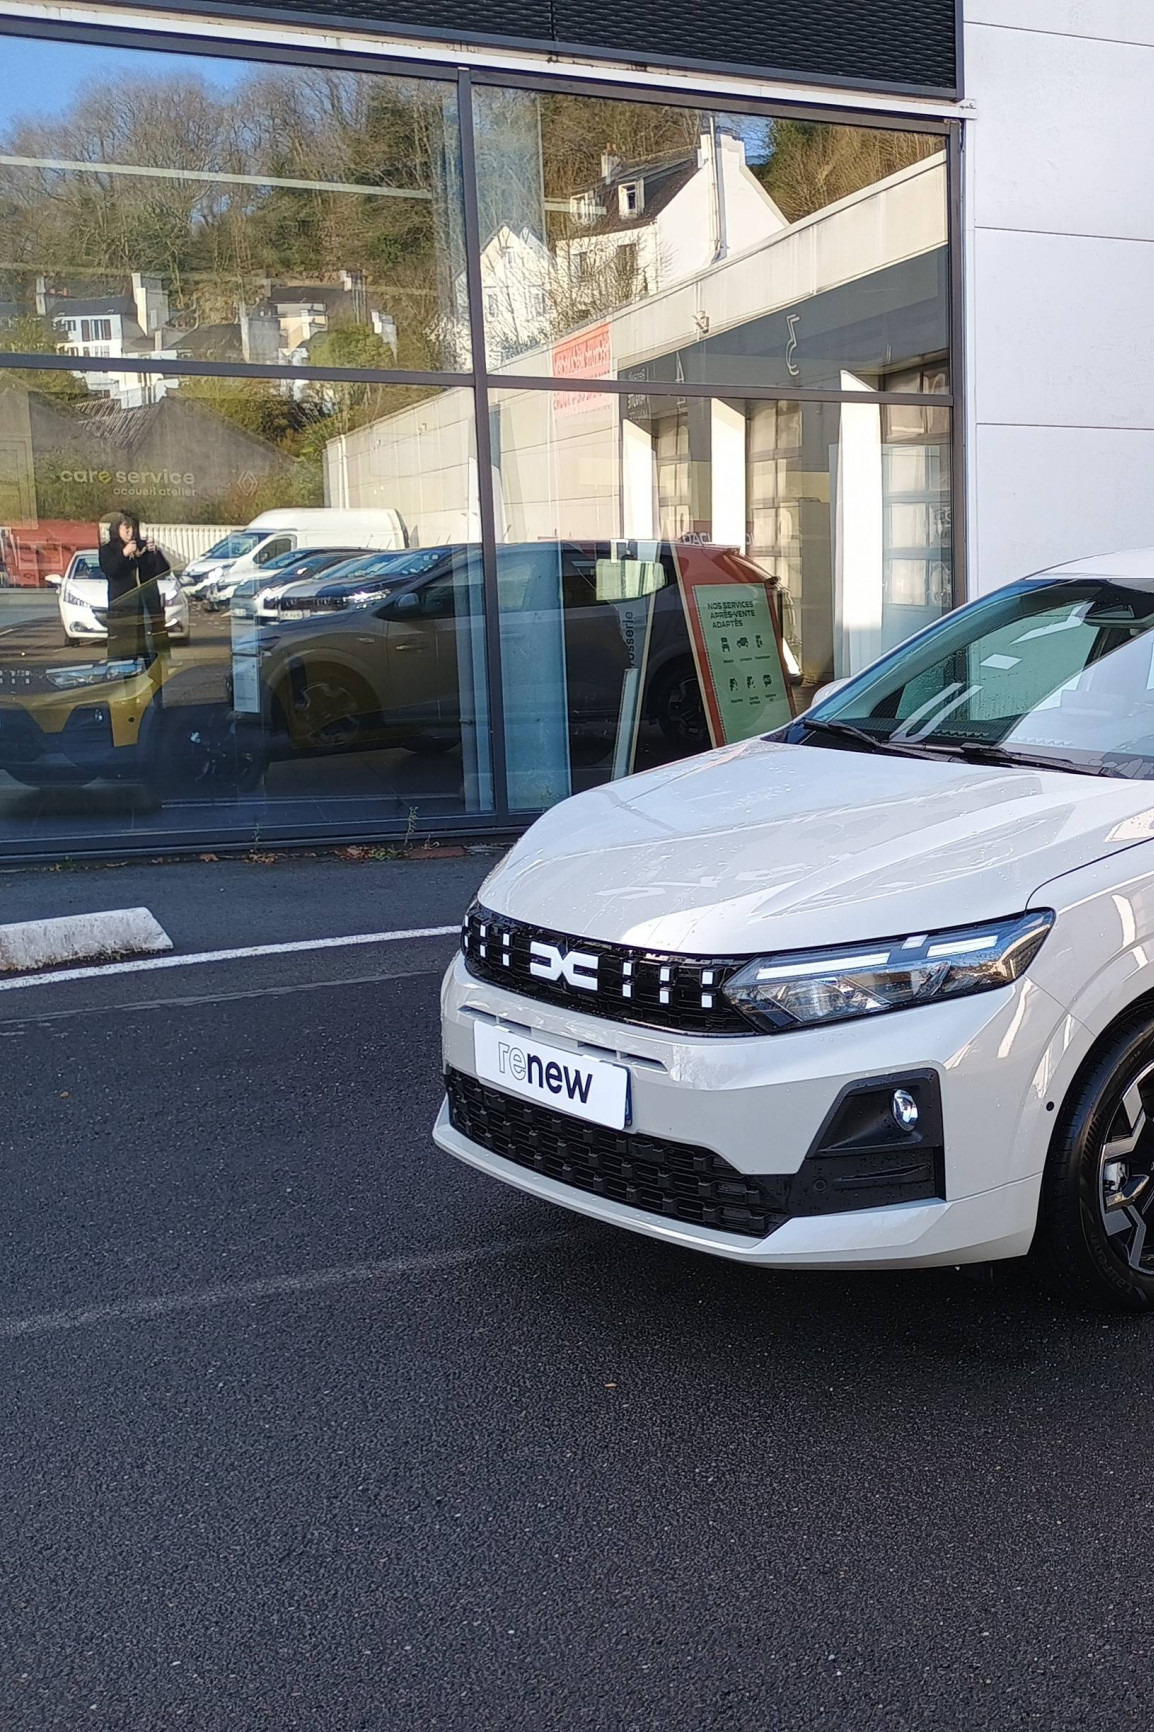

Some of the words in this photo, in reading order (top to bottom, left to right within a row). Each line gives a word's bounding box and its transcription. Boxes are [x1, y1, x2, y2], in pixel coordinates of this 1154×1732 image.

[60, 469, 112, 484] care
[115, 468, 196, 485] service
[113, 486, 157, 497] accueil
[159, 486, 196, 497] atelier
[707, 602, 722, 611] NOS
[723, 600, 754, 609] SERVICES
[710, 609, 756, 620] APRÈS-VENTE
[622, 611, 636, 669] rosserie
[498, 1041, 593, 1104] renew
